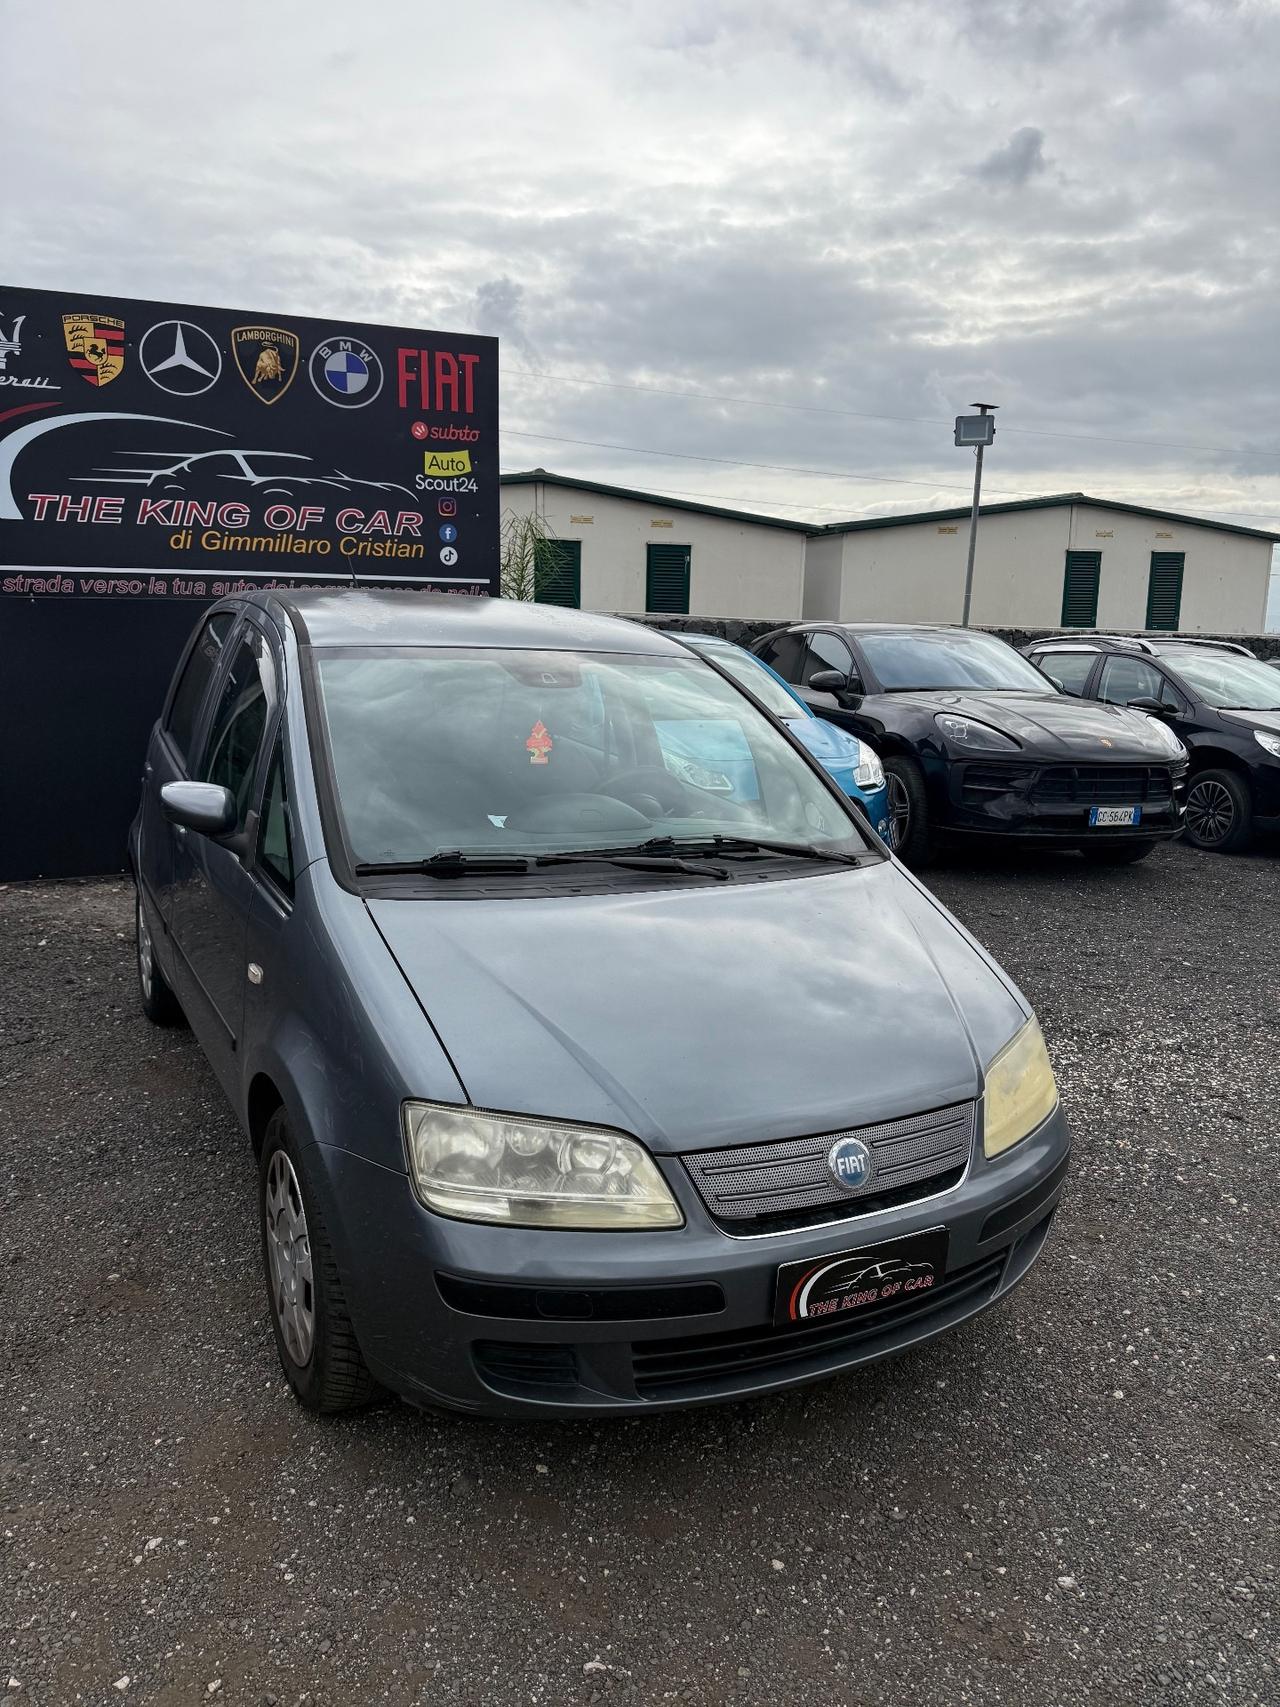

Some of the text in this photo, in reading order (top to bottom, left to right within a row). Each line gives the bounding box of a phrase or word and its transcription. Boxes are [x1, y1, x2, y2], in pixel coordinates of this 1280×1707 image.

[63, 315, 124, 328] PORSCHE
[236, 330, 295, 348] LAMBORGHINI
[318, 340, 374, 363] BMW
[398, 348, 480, 414] FIAT
[430, 424, 480, 441] subito
[428, 455, 466, 472] Auto
[415, 474, 479, 493] Scout24
[28, 494, 424, 537] THE KING OF CAR
[169, 530, 425, 558] di Gimmillaro Cristian
[2, 575, 75, 593] strada
[80, 579, 142, 594] verso
[148, 577, 168, 594] la
[172, 578, 207, 595] tua
[836, 1153, 865, 1176] FIAT
[809, 1275, 935, 1316] THE KING OF CAR
